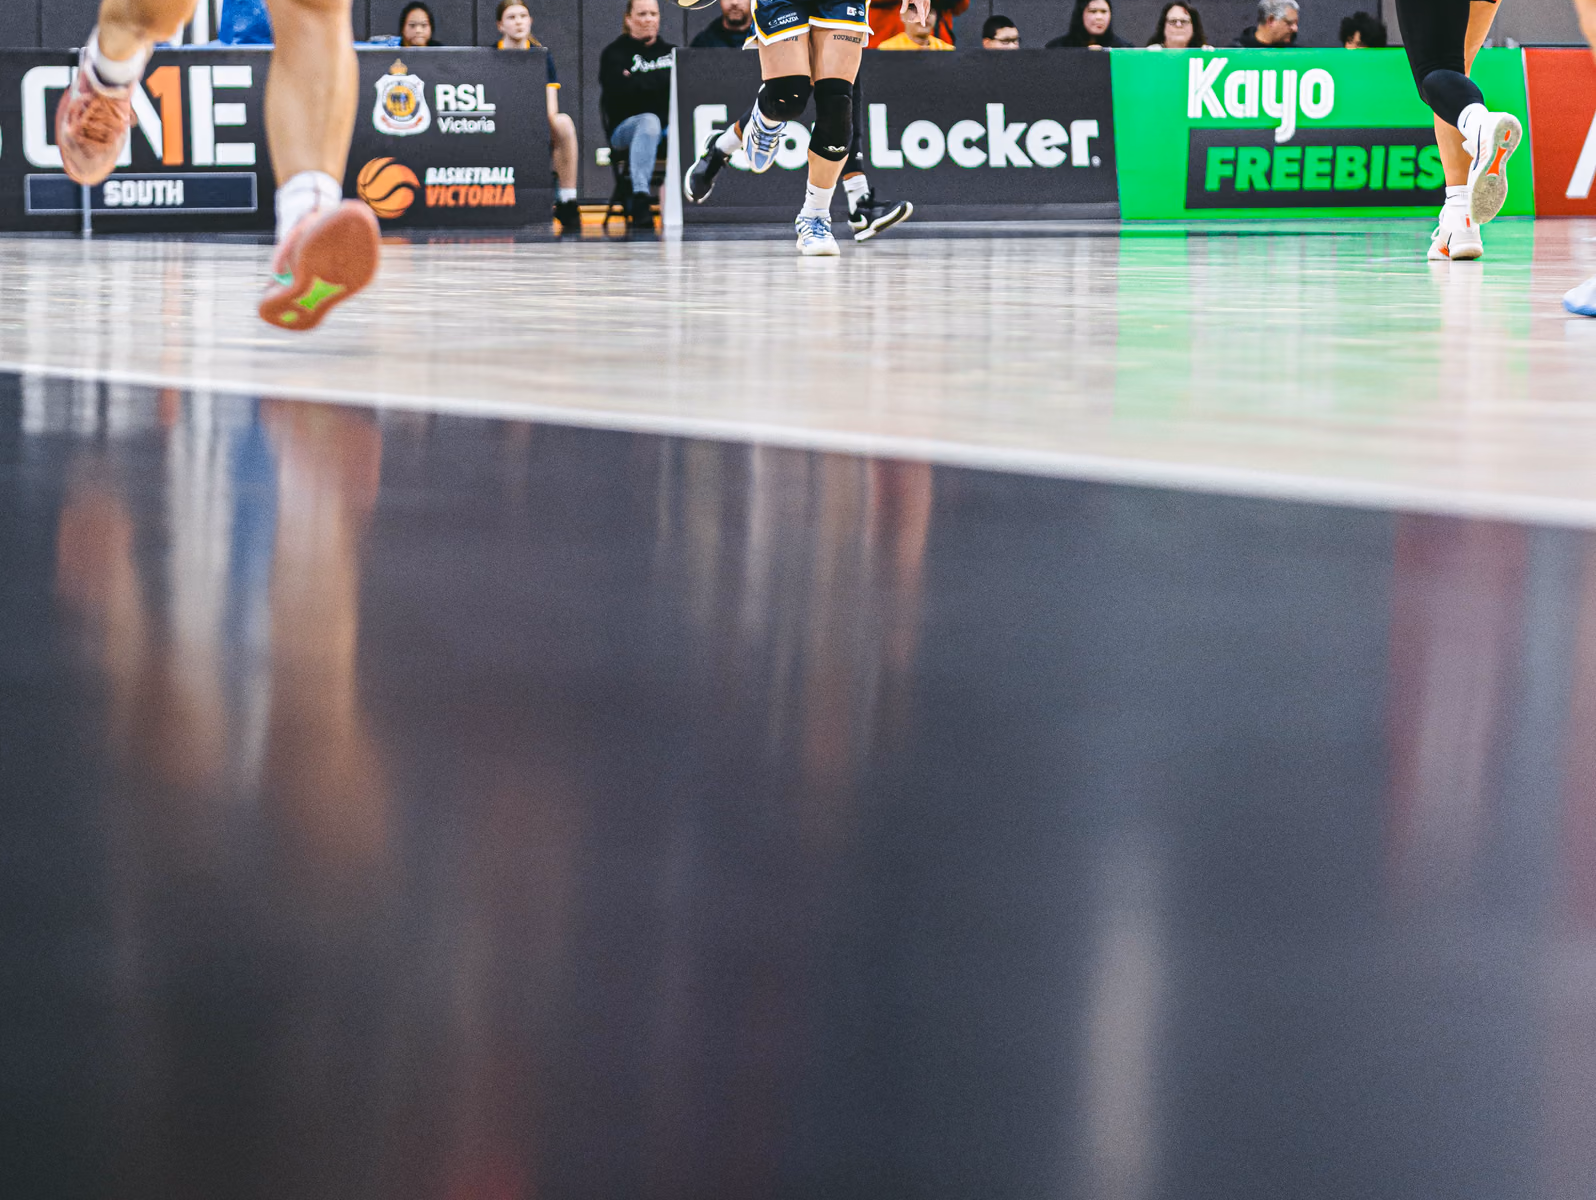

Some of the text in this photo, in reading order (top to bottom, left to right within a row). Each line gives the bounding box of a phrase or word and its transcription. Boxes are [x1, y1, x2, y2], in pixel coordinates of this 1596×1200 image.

[434, 83, 497, 112] RSL
[1187, 57, 1335, 143] Kayo
[437, 115, 496, 134] Victoria
[424, 166, 515, 185] BASKETBALL
[1204, 145, 1445, 192] FREEBIES
[102, 179, 184, 206] SOUTH
[424, 184, 516, 207] VICTORIA
